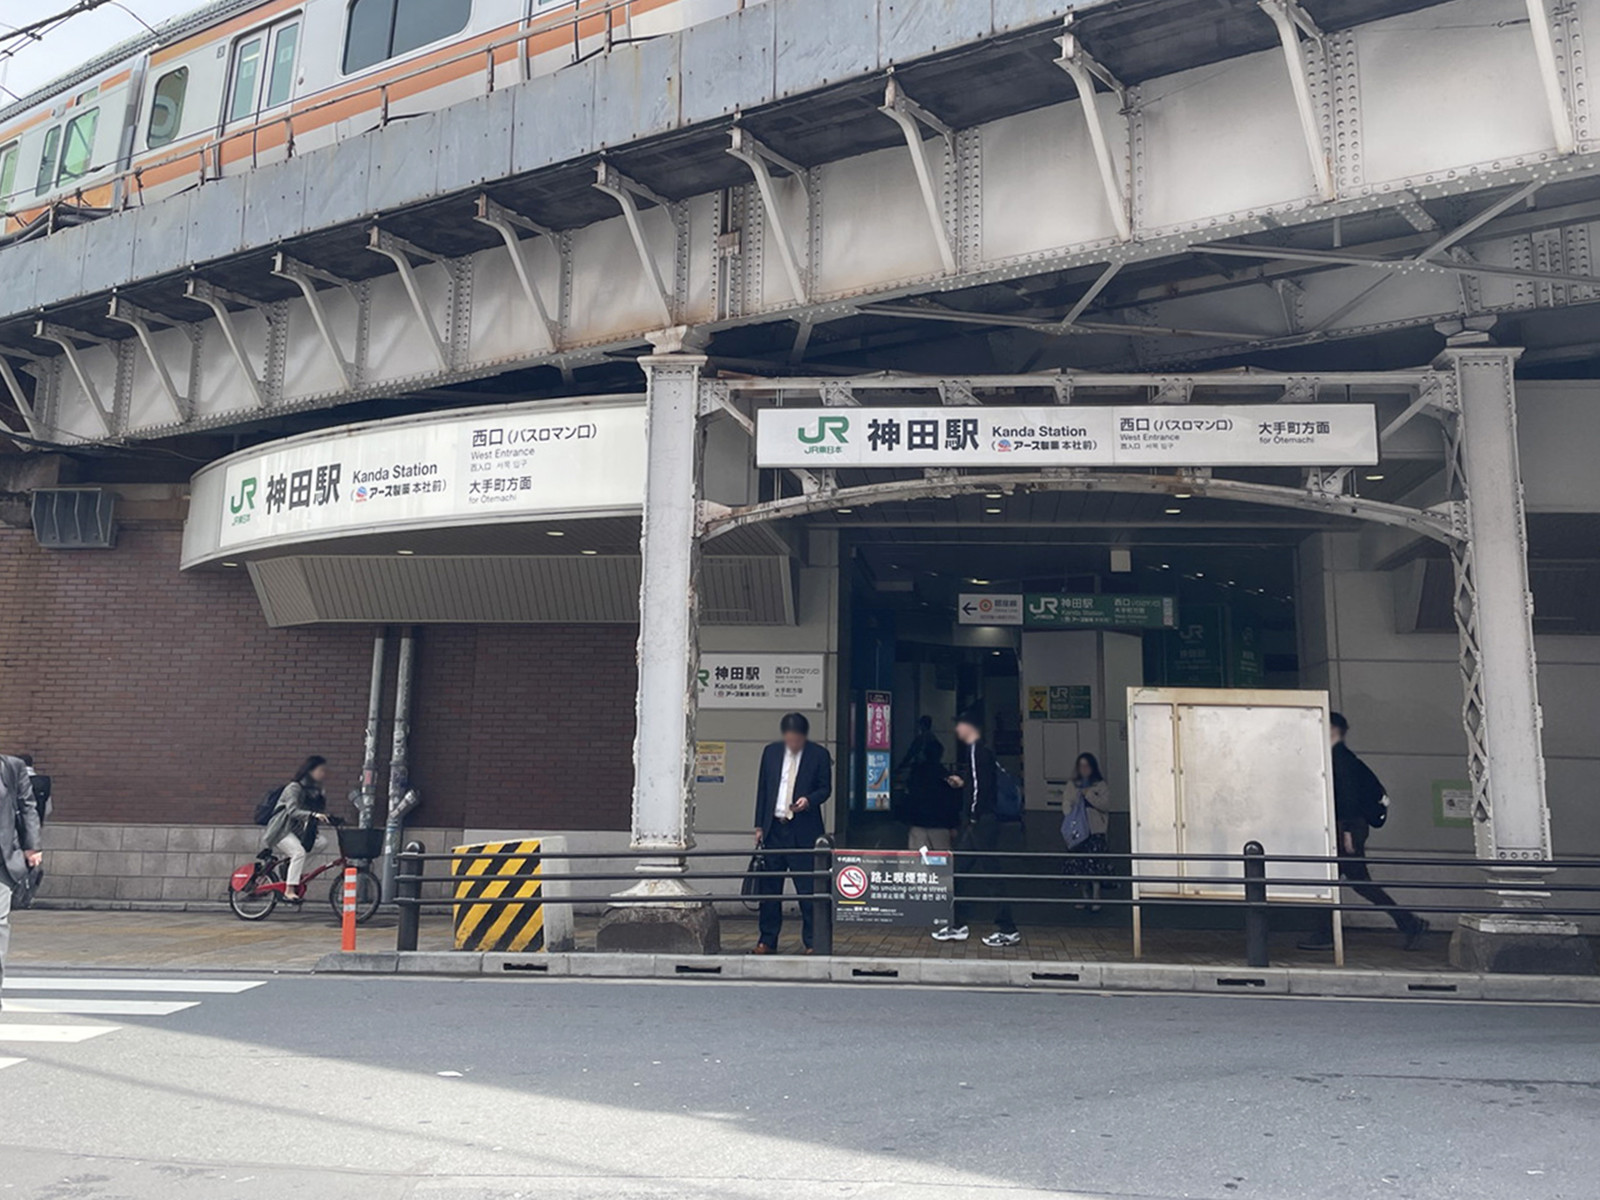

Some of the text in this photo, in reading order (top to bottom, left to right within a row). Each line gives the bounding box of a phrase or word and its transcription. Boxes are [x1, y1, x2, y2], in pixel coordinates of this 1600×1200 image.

[797, 416, 849, 444] JR
[867, 418, 979, 451] 神田駅
[992, 425, 1087, 437] Kanda Station
[1258, 421, 1330, 435] 大手町方面
[1143, 433, 1180, 441] Entrance
[471, 447, 536, 461] West Entrance
[352, 462, 438, 484] Kanda Station
[265, 463, 342, 516] 神田駅
[469, 476, 532, 494] 大手町方面
[230, 477, 258, 514] JR
[1029, 598, 1059, 614] JR
[1061, 599, 1094, 609] 神田駅
[715, 666, 760, 681] 神田駅
[714, 682, 738, 690] Kanda
[739, 682, 765, 690] Station
[1051, 687, 1069, 699] JR
[871, 871, 940, 885] 路上喫煙禁止
[881, 884, 907, 893] smoking
